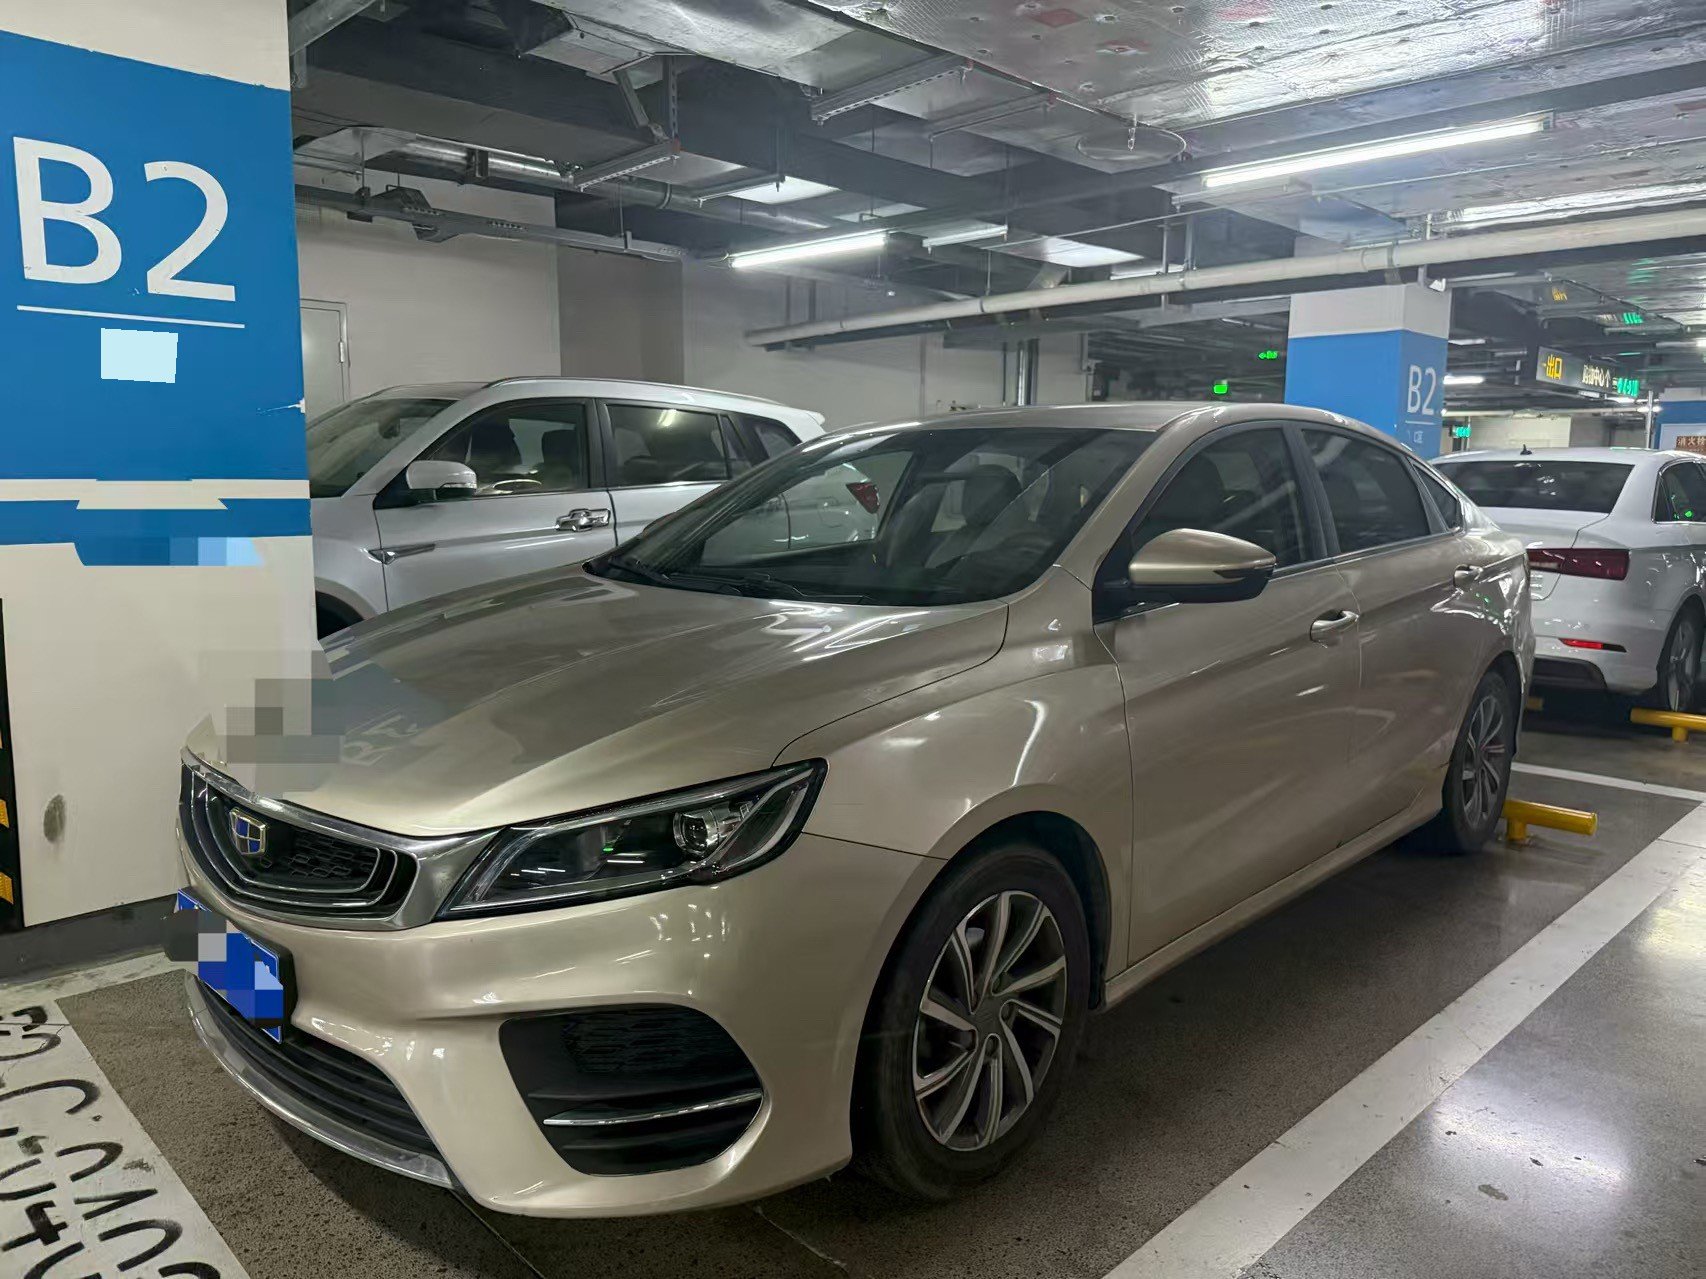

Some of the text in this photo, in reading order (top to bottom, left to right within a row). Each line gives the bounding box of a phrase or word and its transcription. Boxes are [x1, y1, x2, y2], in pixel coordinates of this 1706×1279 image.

[13, 137, 237, 302] B2
[1407, 365, 1437, 416] B2
[1546, 354, 1563, 380] 出口
